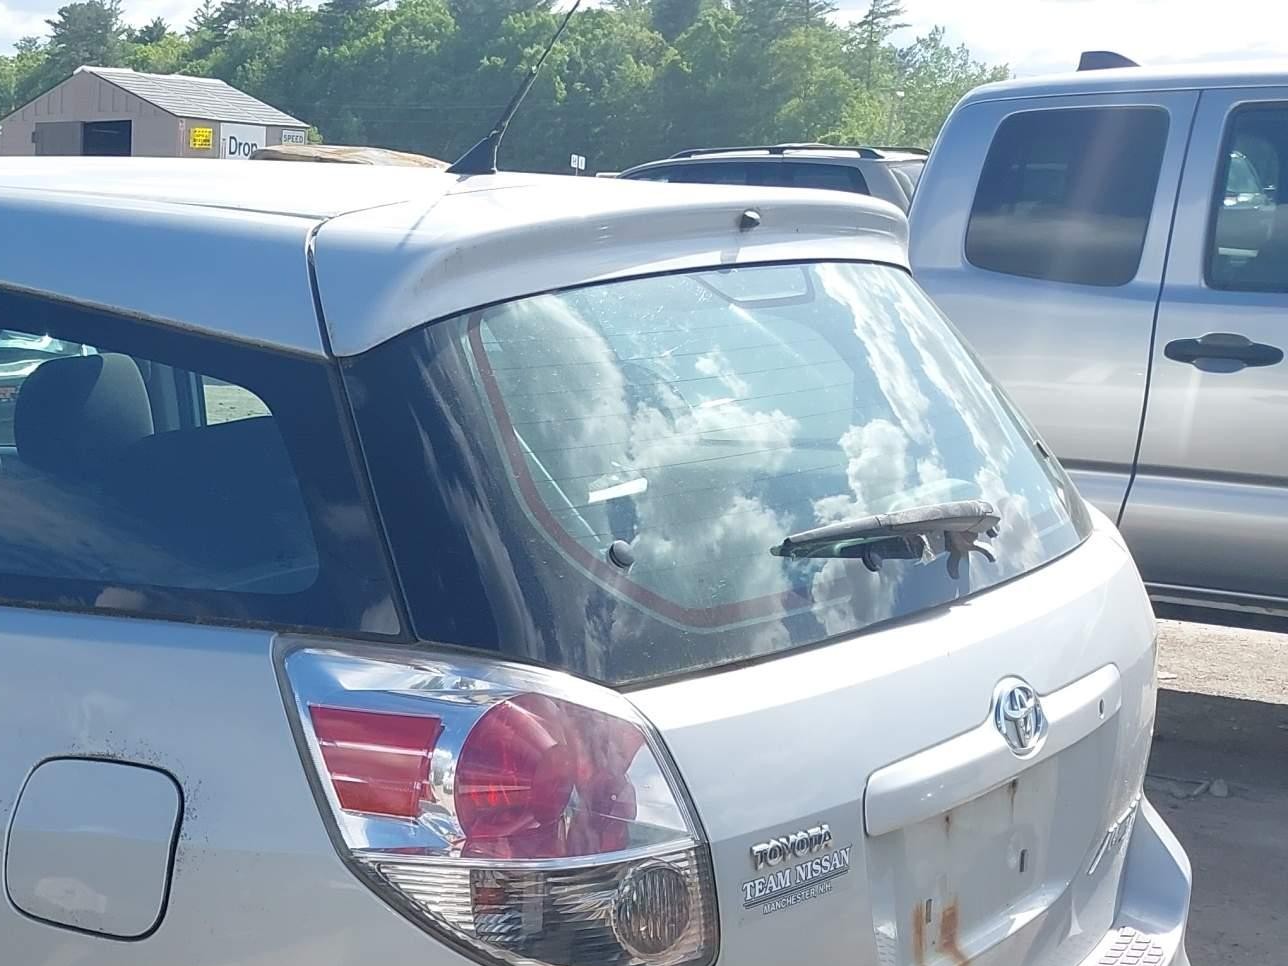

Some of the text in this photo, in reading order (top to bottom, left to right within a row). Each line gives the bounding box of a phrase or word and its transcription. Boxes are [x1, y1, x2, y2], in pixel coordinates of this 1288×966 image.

[283, 134, 304, 144] SPEED
[751, 824, 832, 871] TOYOTA
[743, 846, 851, 901] TEAM NISSAN
